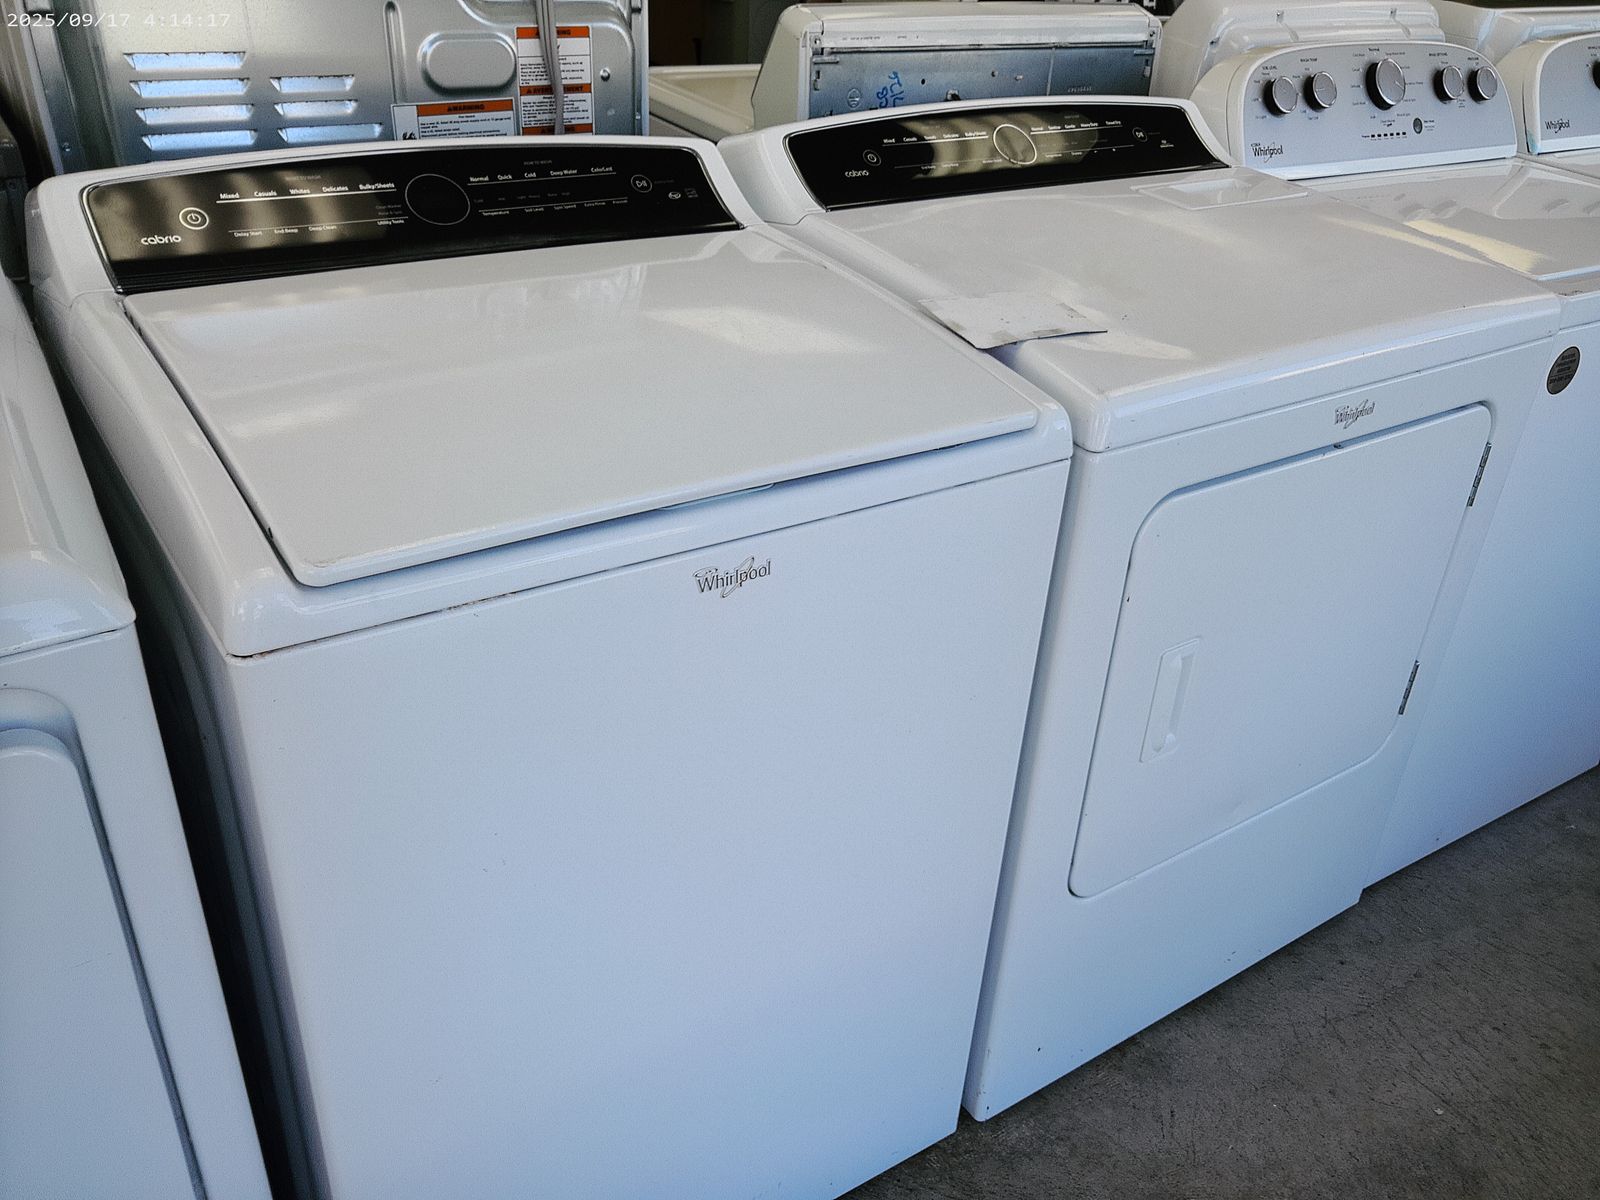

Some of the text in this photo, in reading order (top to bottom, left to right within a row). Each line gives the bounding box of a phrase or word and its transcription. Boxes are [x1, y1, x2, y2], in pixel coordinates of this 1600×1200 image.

[1545, 118, 1571, 133] Whirlpool
[1252, 143, 1284, 162] Whirlpool
[141, 234, 182, 246] cabrio
[1335, 400, 1376, 427] Whirlpool
[695, 558, 771, 596] Whirlpool
